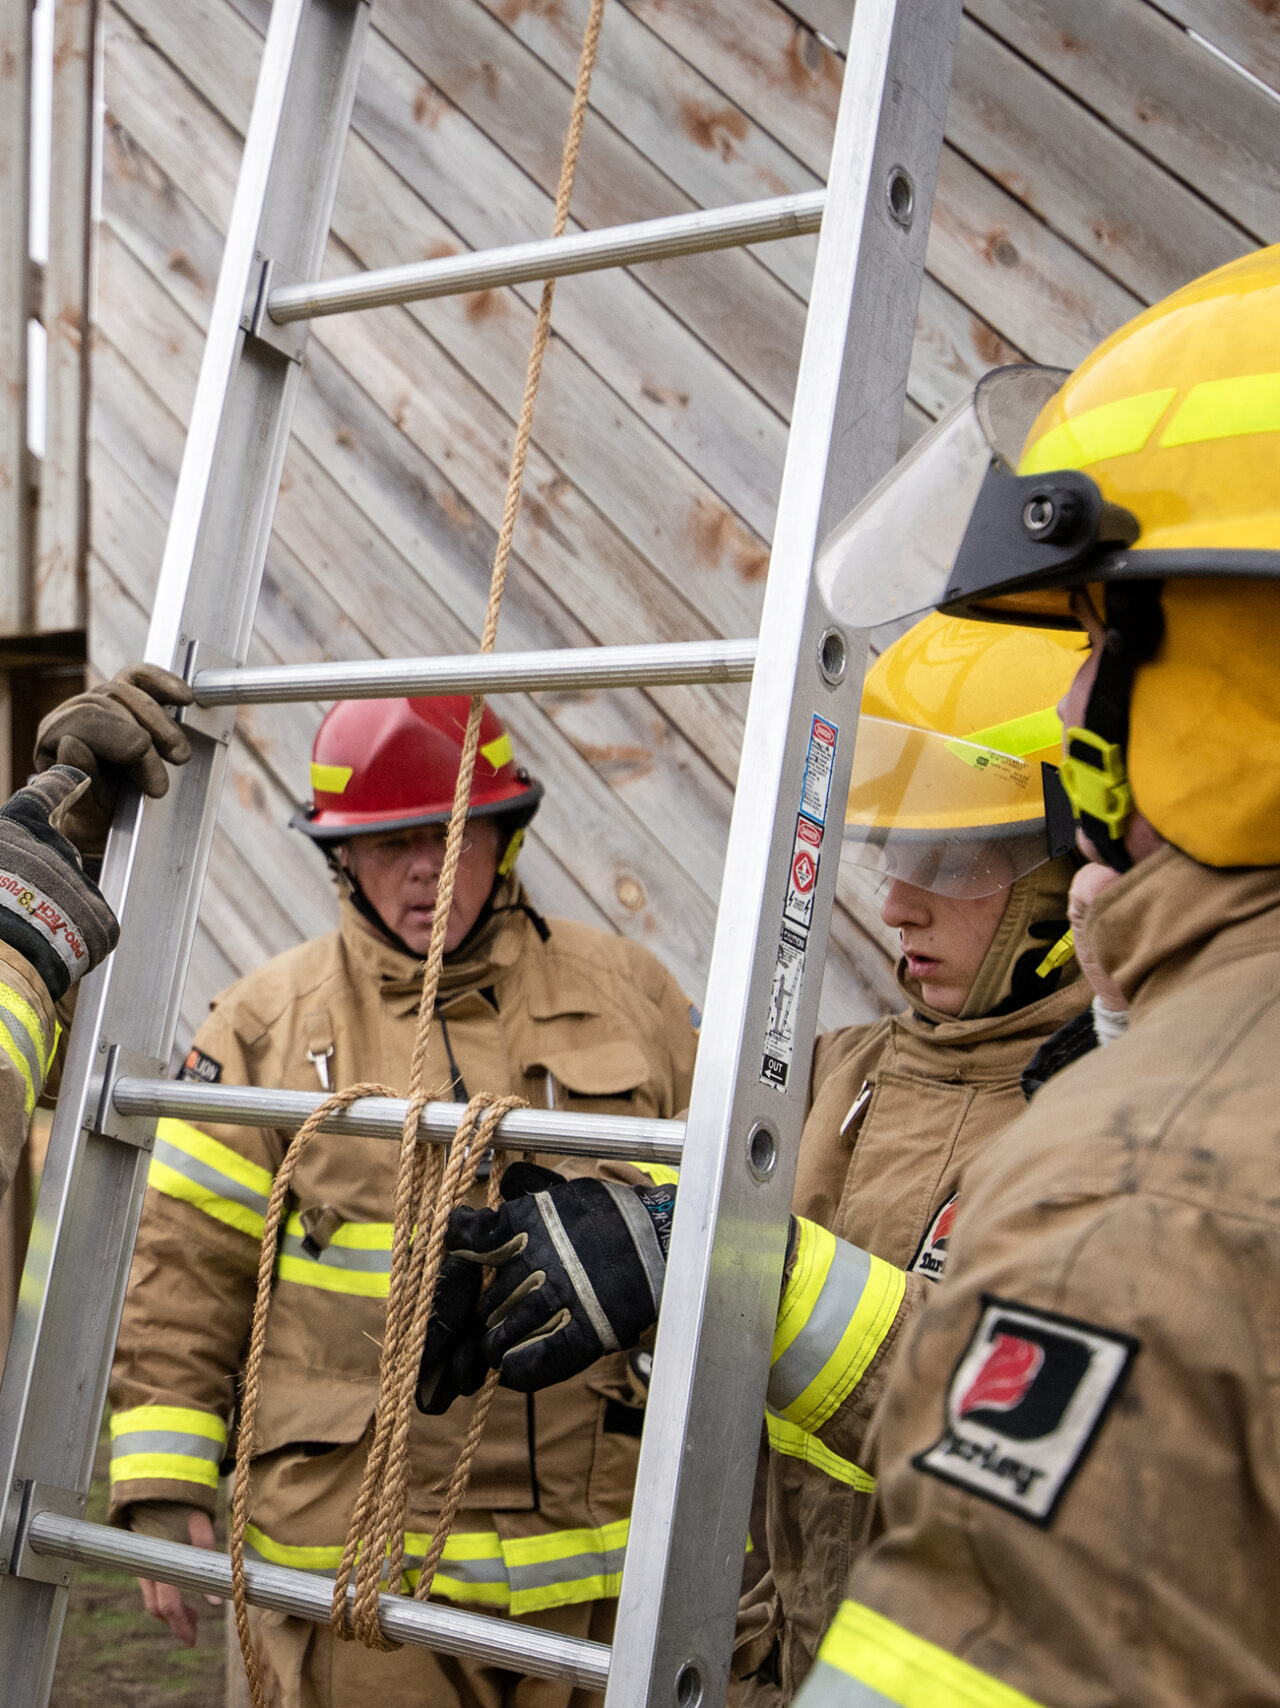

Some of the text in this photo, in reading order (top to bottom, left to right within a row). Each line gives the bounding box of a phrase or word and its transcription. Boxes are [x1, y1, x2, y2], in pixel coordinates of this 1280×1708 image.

[195, 1055, 219, 1081] LION
[768, 1059, 783, 1073] OUT
[919, 1252, 945, 1273] Dar
